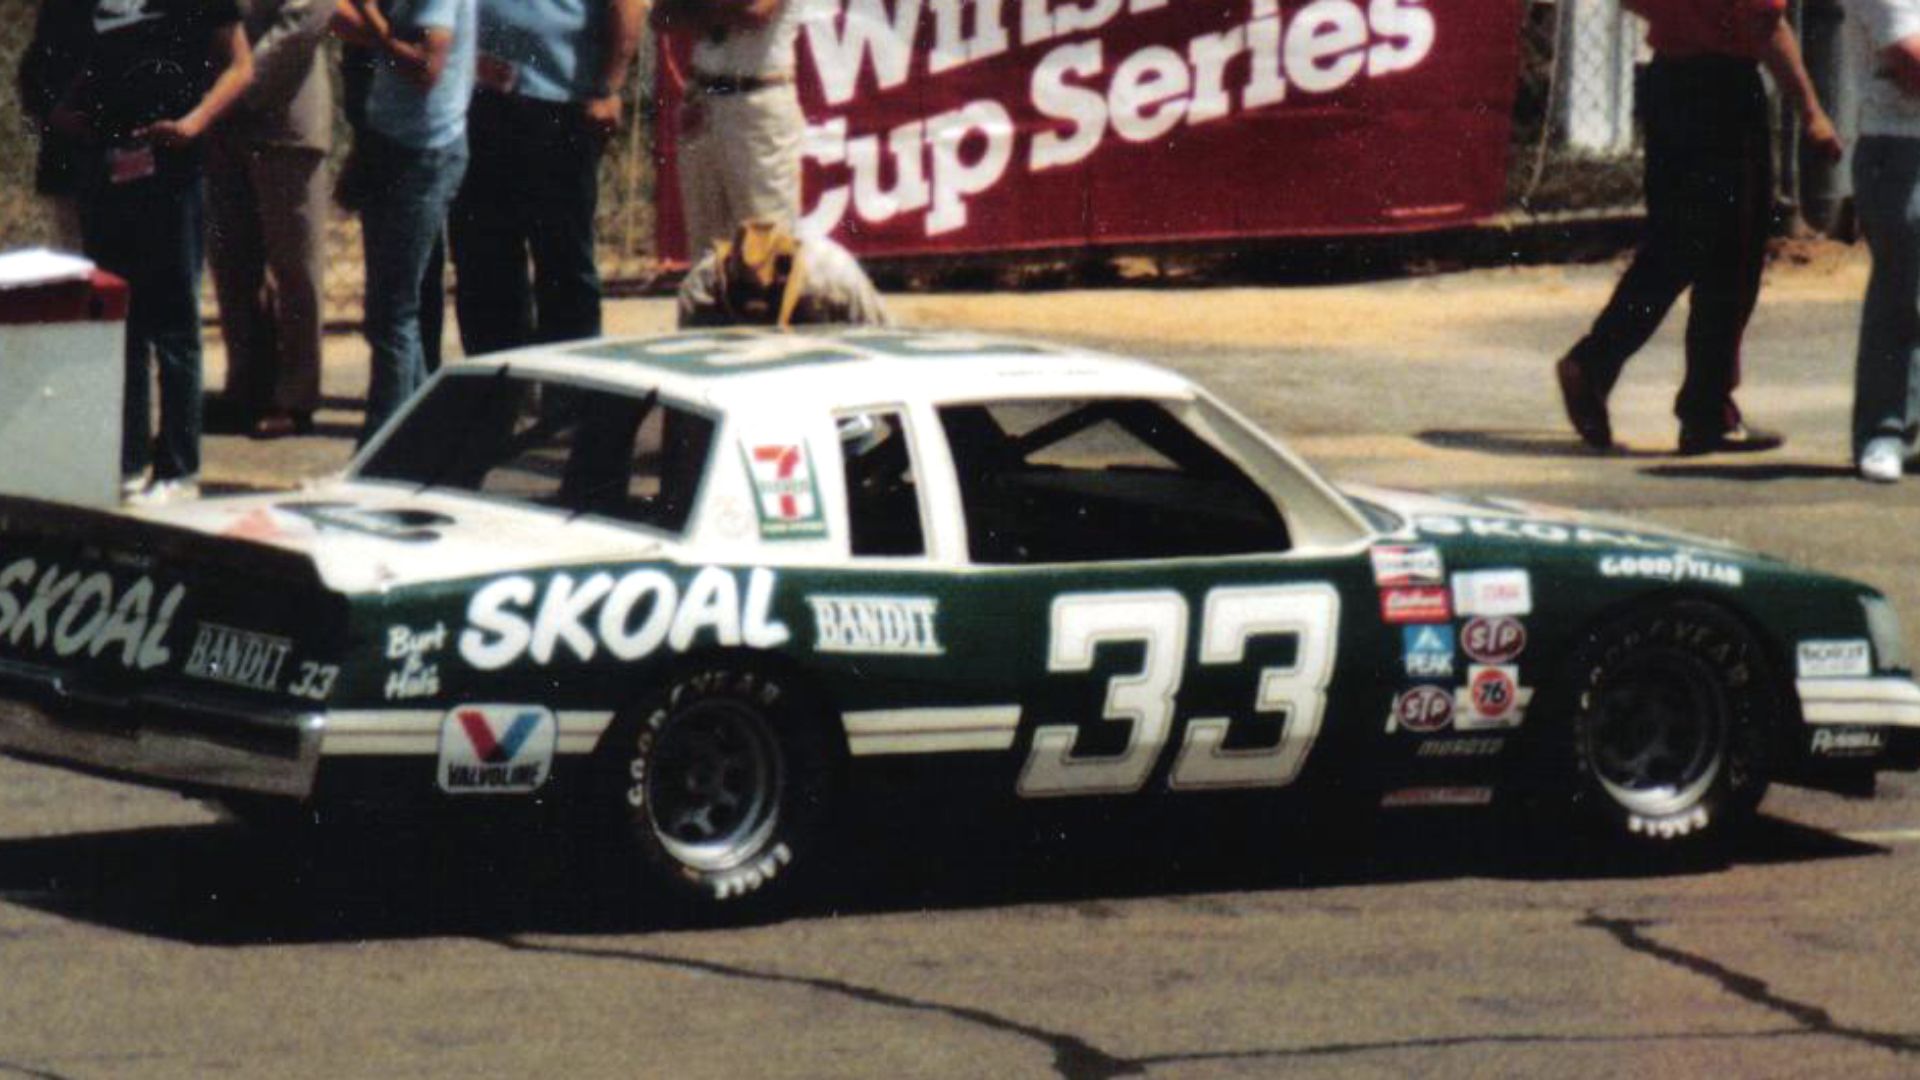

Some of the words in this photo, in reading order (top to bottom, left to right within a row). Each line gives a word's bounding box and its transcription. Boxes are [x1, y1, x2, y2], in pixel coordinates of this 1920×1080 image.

[1029, 0, 1435, 171] Series
[1600, 549, 1743, 587] GOODYEAR
[0, 557, 186, 671] SKOAL
[459, 566, 790, 670] SKOAL
[810, 596, 943, 654] BANDIT
[387, 622, 446, 660] Burt
[1470, 618, 1518, 653] STP
[184, 621, 293, 691] BANDIT
[288, 661, 341, 700] 33
[1406, 652, 1453, 677] PEAK
[1016, 580, 1341, 798] 33
[1405, 689, 1447, 722] STP
[1482, 681, 1507, 705] 76
[448, 761, 542, 787] VALVOLINE
